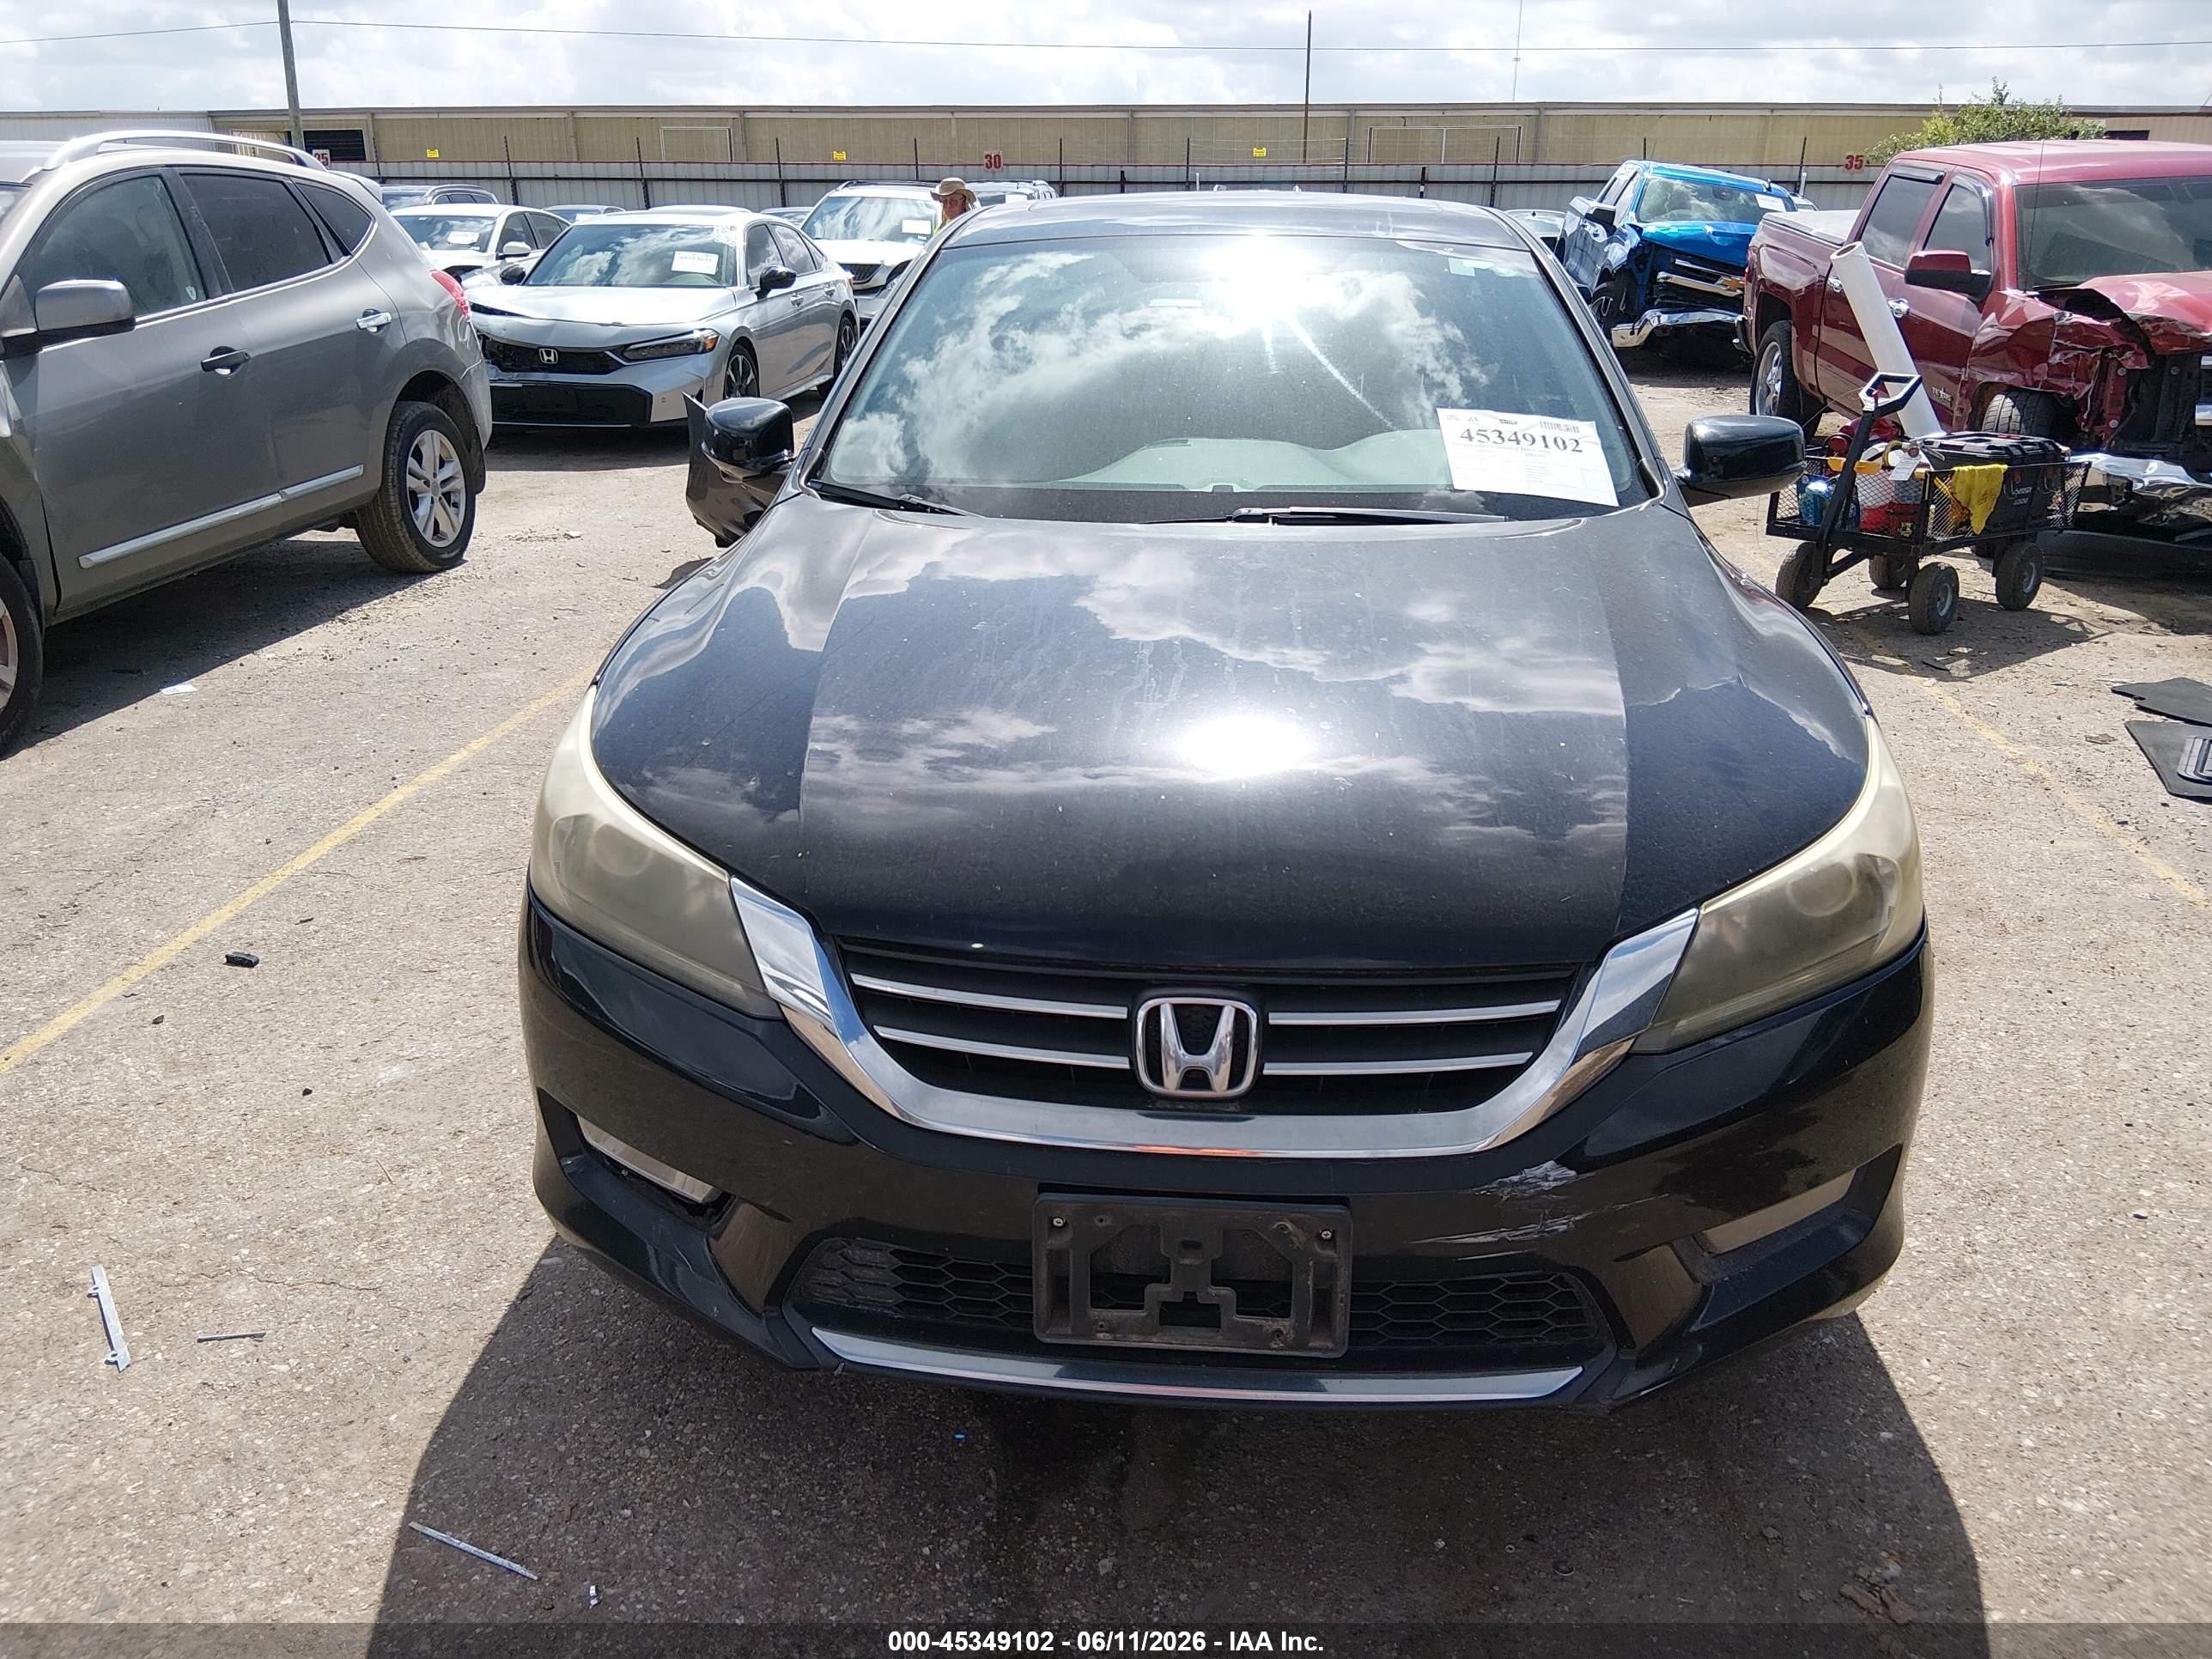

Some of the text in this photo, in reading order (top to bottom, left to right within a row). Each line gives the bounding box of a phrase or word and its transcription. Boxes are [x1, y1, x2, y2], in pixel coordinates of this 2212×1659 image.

[984, 154, 1002, 169] 30
[1844, 155, 1864, 170] 35
[1460, 428, 1583, 453] 45349102
